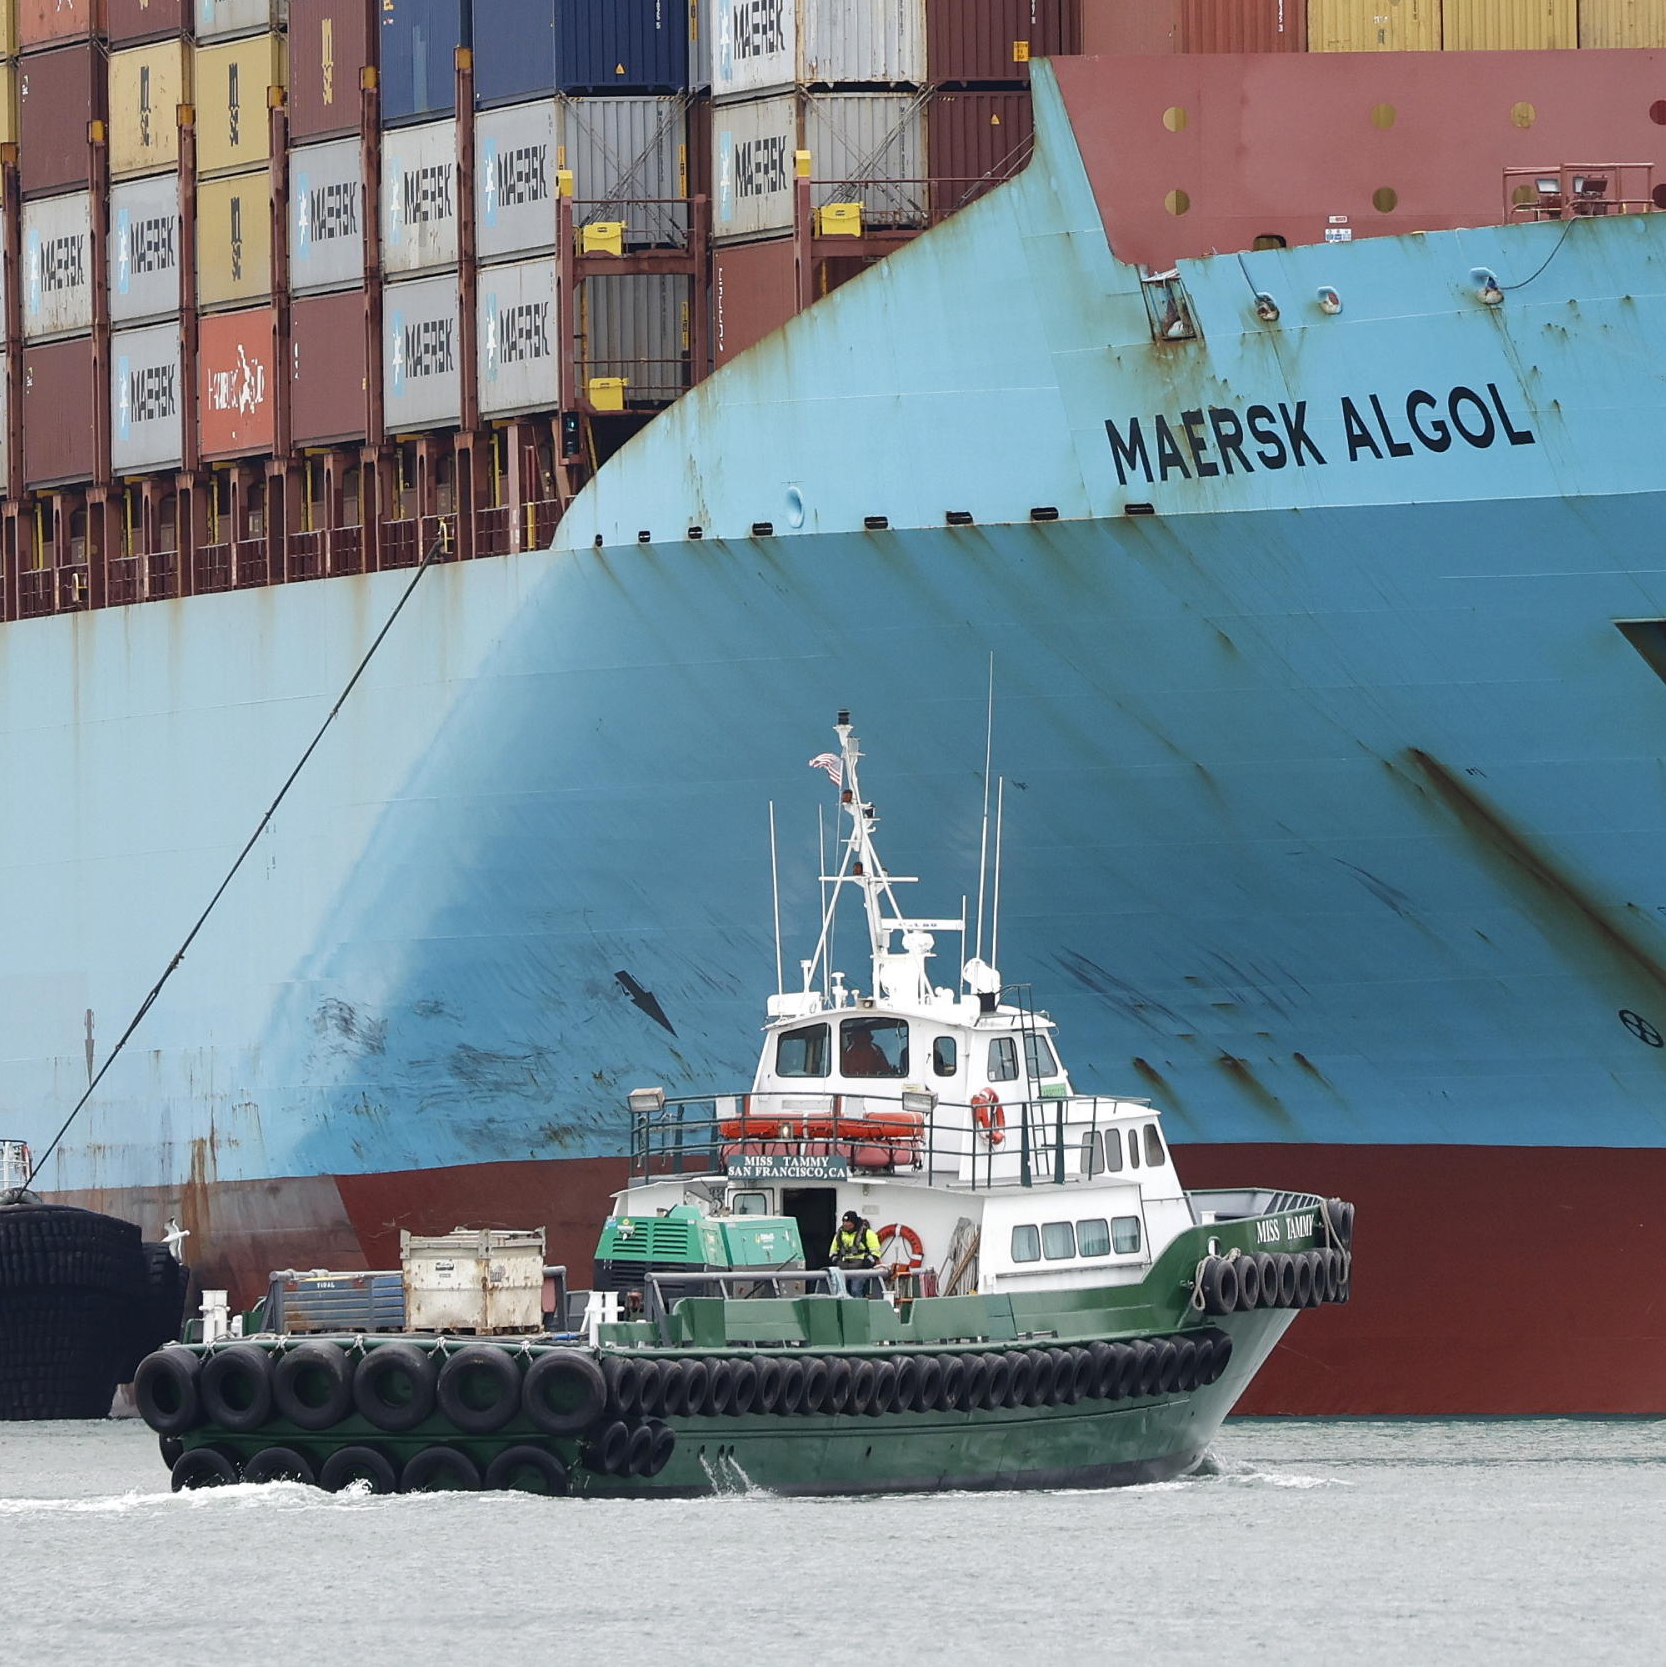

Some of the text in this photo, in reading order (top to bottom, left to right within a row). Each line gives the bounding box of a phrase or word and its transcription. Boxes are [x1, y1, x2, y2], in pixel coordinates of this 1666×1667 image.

[405, 164, 452, 224] MAERSK
[498, 144, 547, 206] MAERSK
[736, 136, 787, 198] MAERSK
[311, 182, 357, 242] MAERSK
[41, 235, 84, 292] MAERSK
[131, 216, 175, 274] MAERSK
[406, 318, 453, 378] MAERSK
[500, 302, 550, 363] MAERSK
[131, 364, 175, 422] MAERSK
[1104, 383, 1535, 485] MAERSK ALGOL
[728, 1166, 751, 1177] SAN
[744, 1157, 829, 1167] MISS TAMMY
[1256, 1214, 1315, 1244] MISS TAMMY
